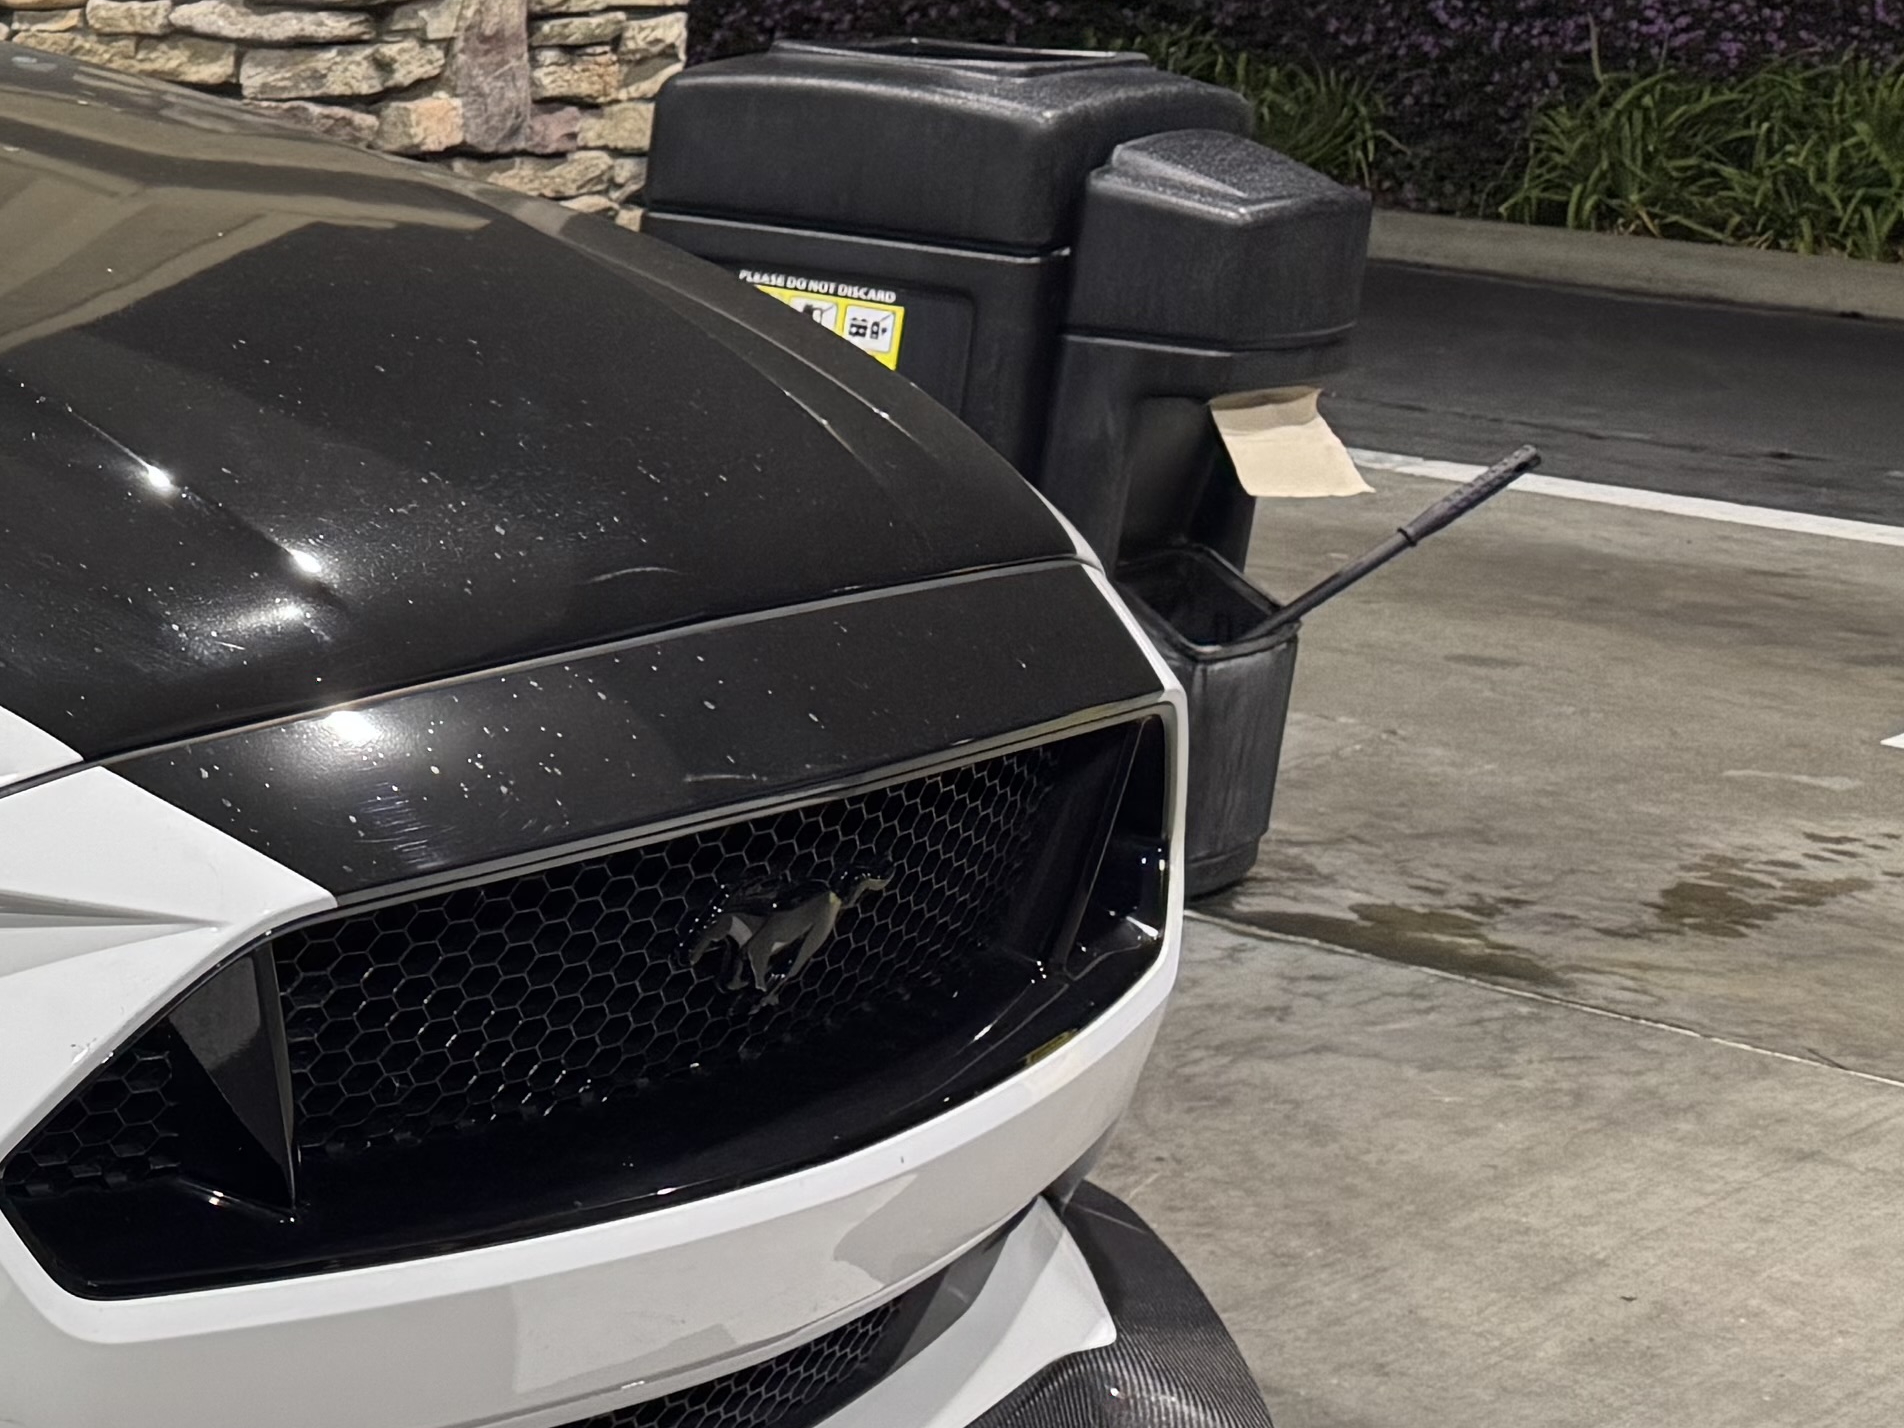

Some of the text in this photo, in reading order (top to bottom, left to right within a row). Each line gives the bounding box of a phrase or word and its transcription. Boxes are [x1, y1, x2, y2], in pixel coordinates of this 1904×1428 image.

[739, 269, 897, 303] PLEASE DO NOT DISCARD
